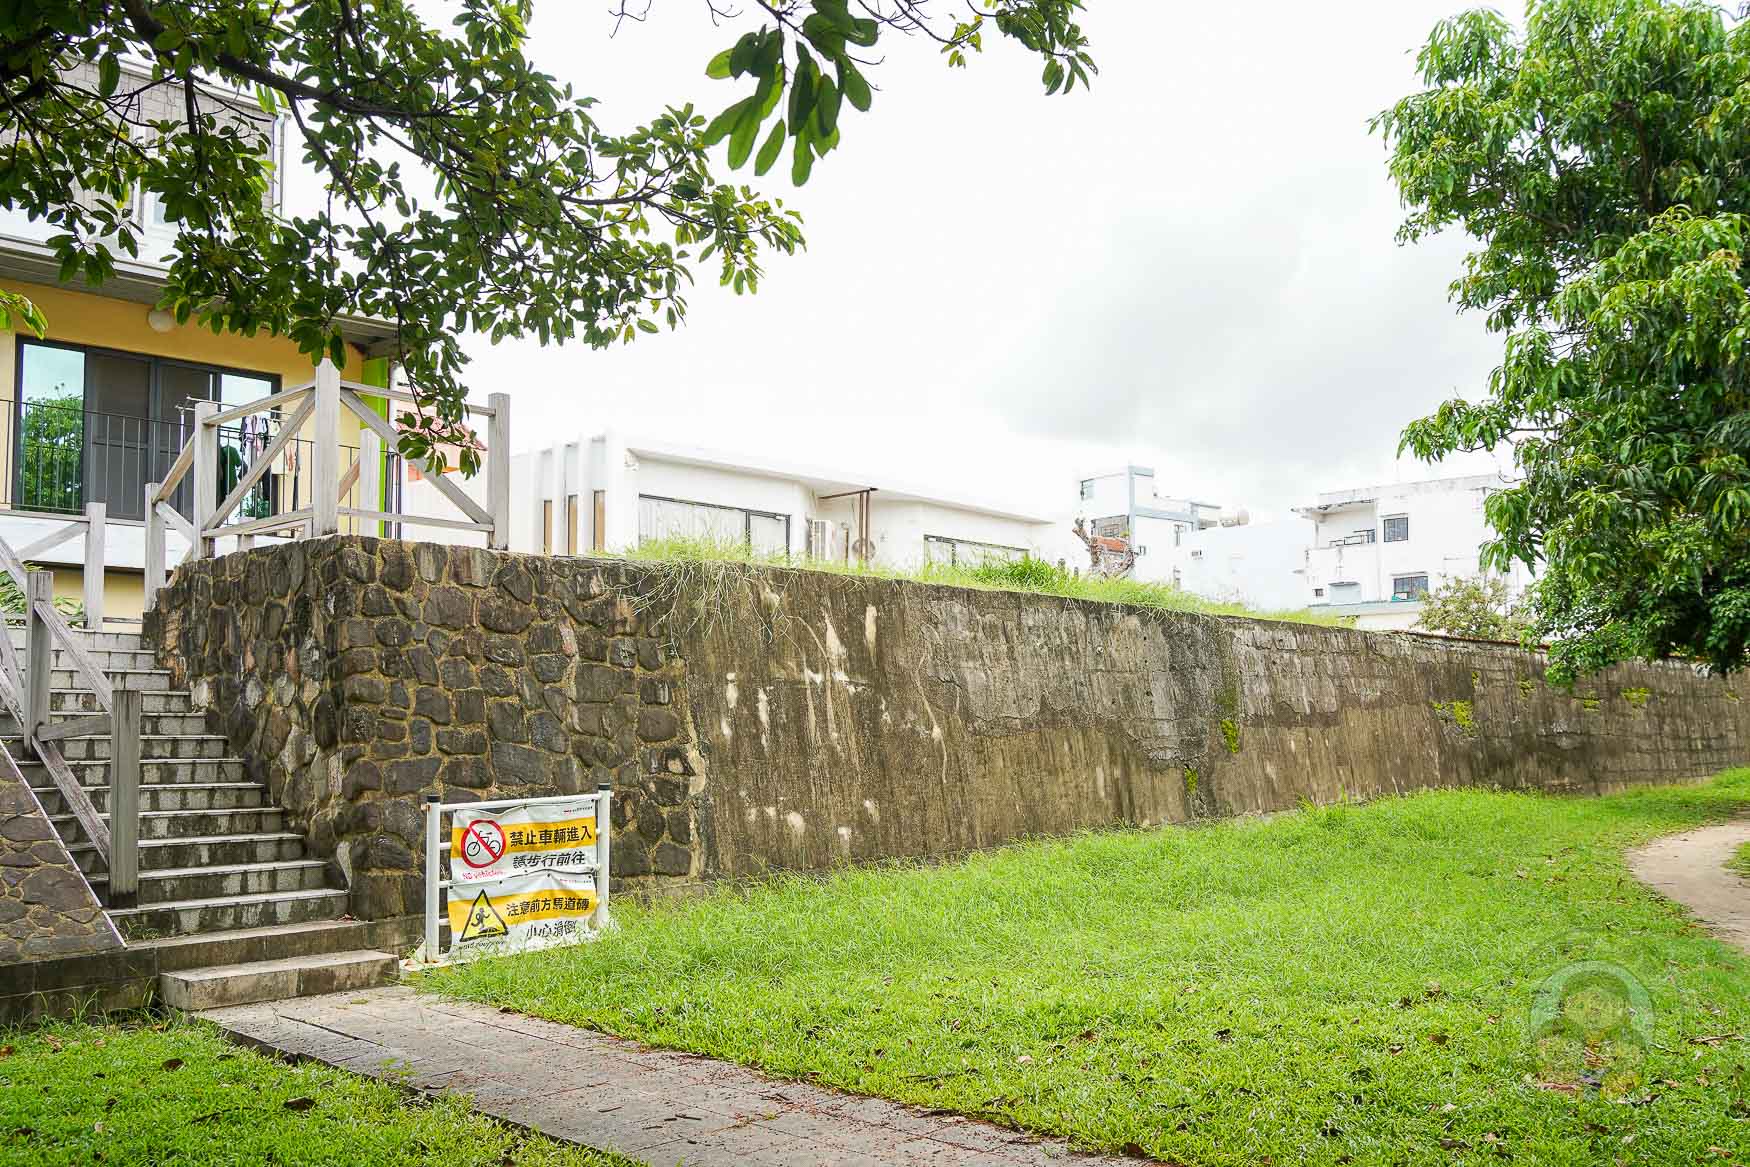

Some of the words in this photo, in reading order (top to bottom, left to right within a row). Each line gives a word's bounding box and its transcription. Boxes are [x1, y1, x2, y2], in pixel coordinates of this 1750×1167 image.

[510, 825, 592, 848] 禁止車輛進入
[512, 851, 586, 869] 請步行前往
[506, 897, 590, 917] 注意前方馬道磚
